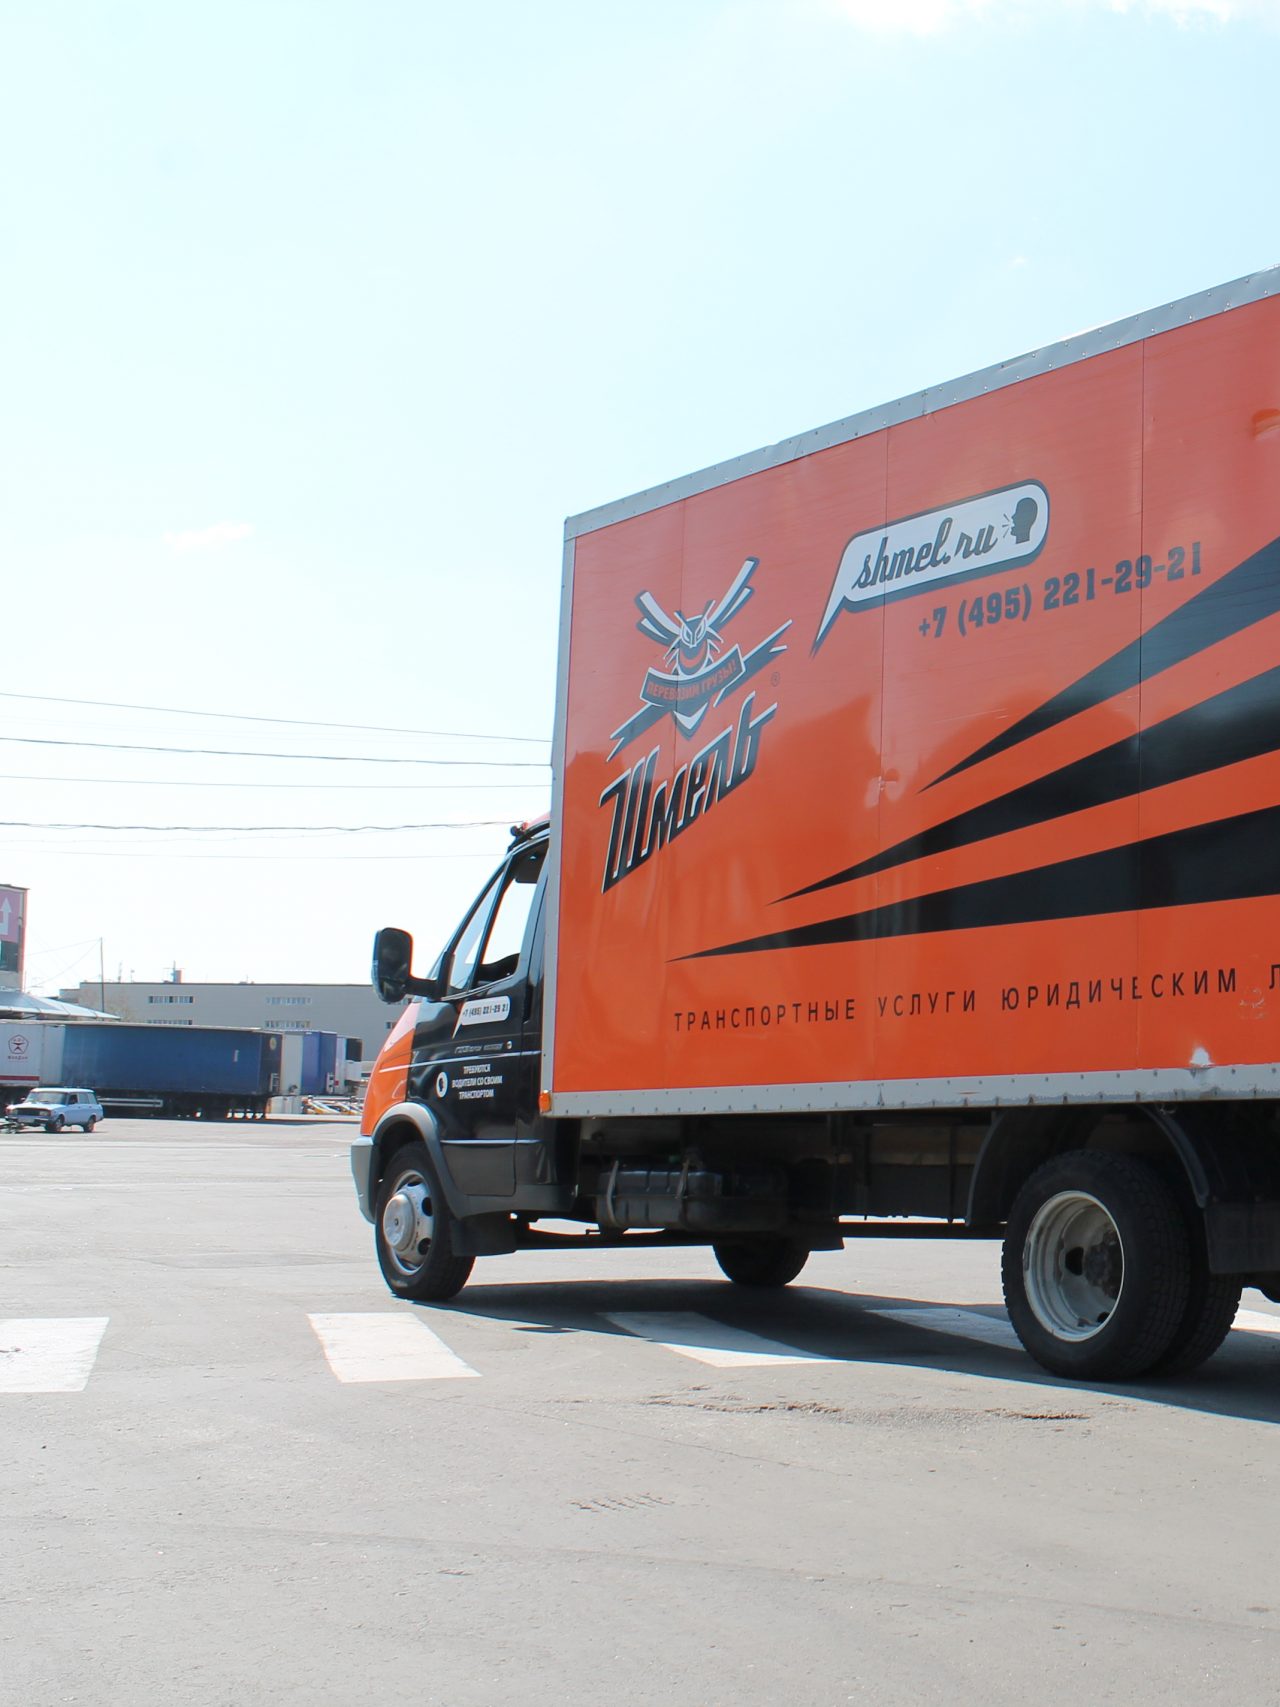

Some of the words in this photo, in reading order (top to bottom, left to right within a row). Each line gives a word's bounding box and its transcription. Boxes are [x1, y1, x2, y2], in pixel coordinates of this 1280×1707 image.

[851, 517, 999, 590] shmel.ru
[919, 606, 948, 638] +7
[957, 583, 1032, 637] (495)
[1043, 541, 1202, 611] 221-29-21
[674, 998, 856, 1032] ТРАНСПОРТНЫЕ
[878, 990, 976, 1017] УСЛУГИ
[1001, 968, 1237, 1010] ЮРИДИЧЕСКИМ
